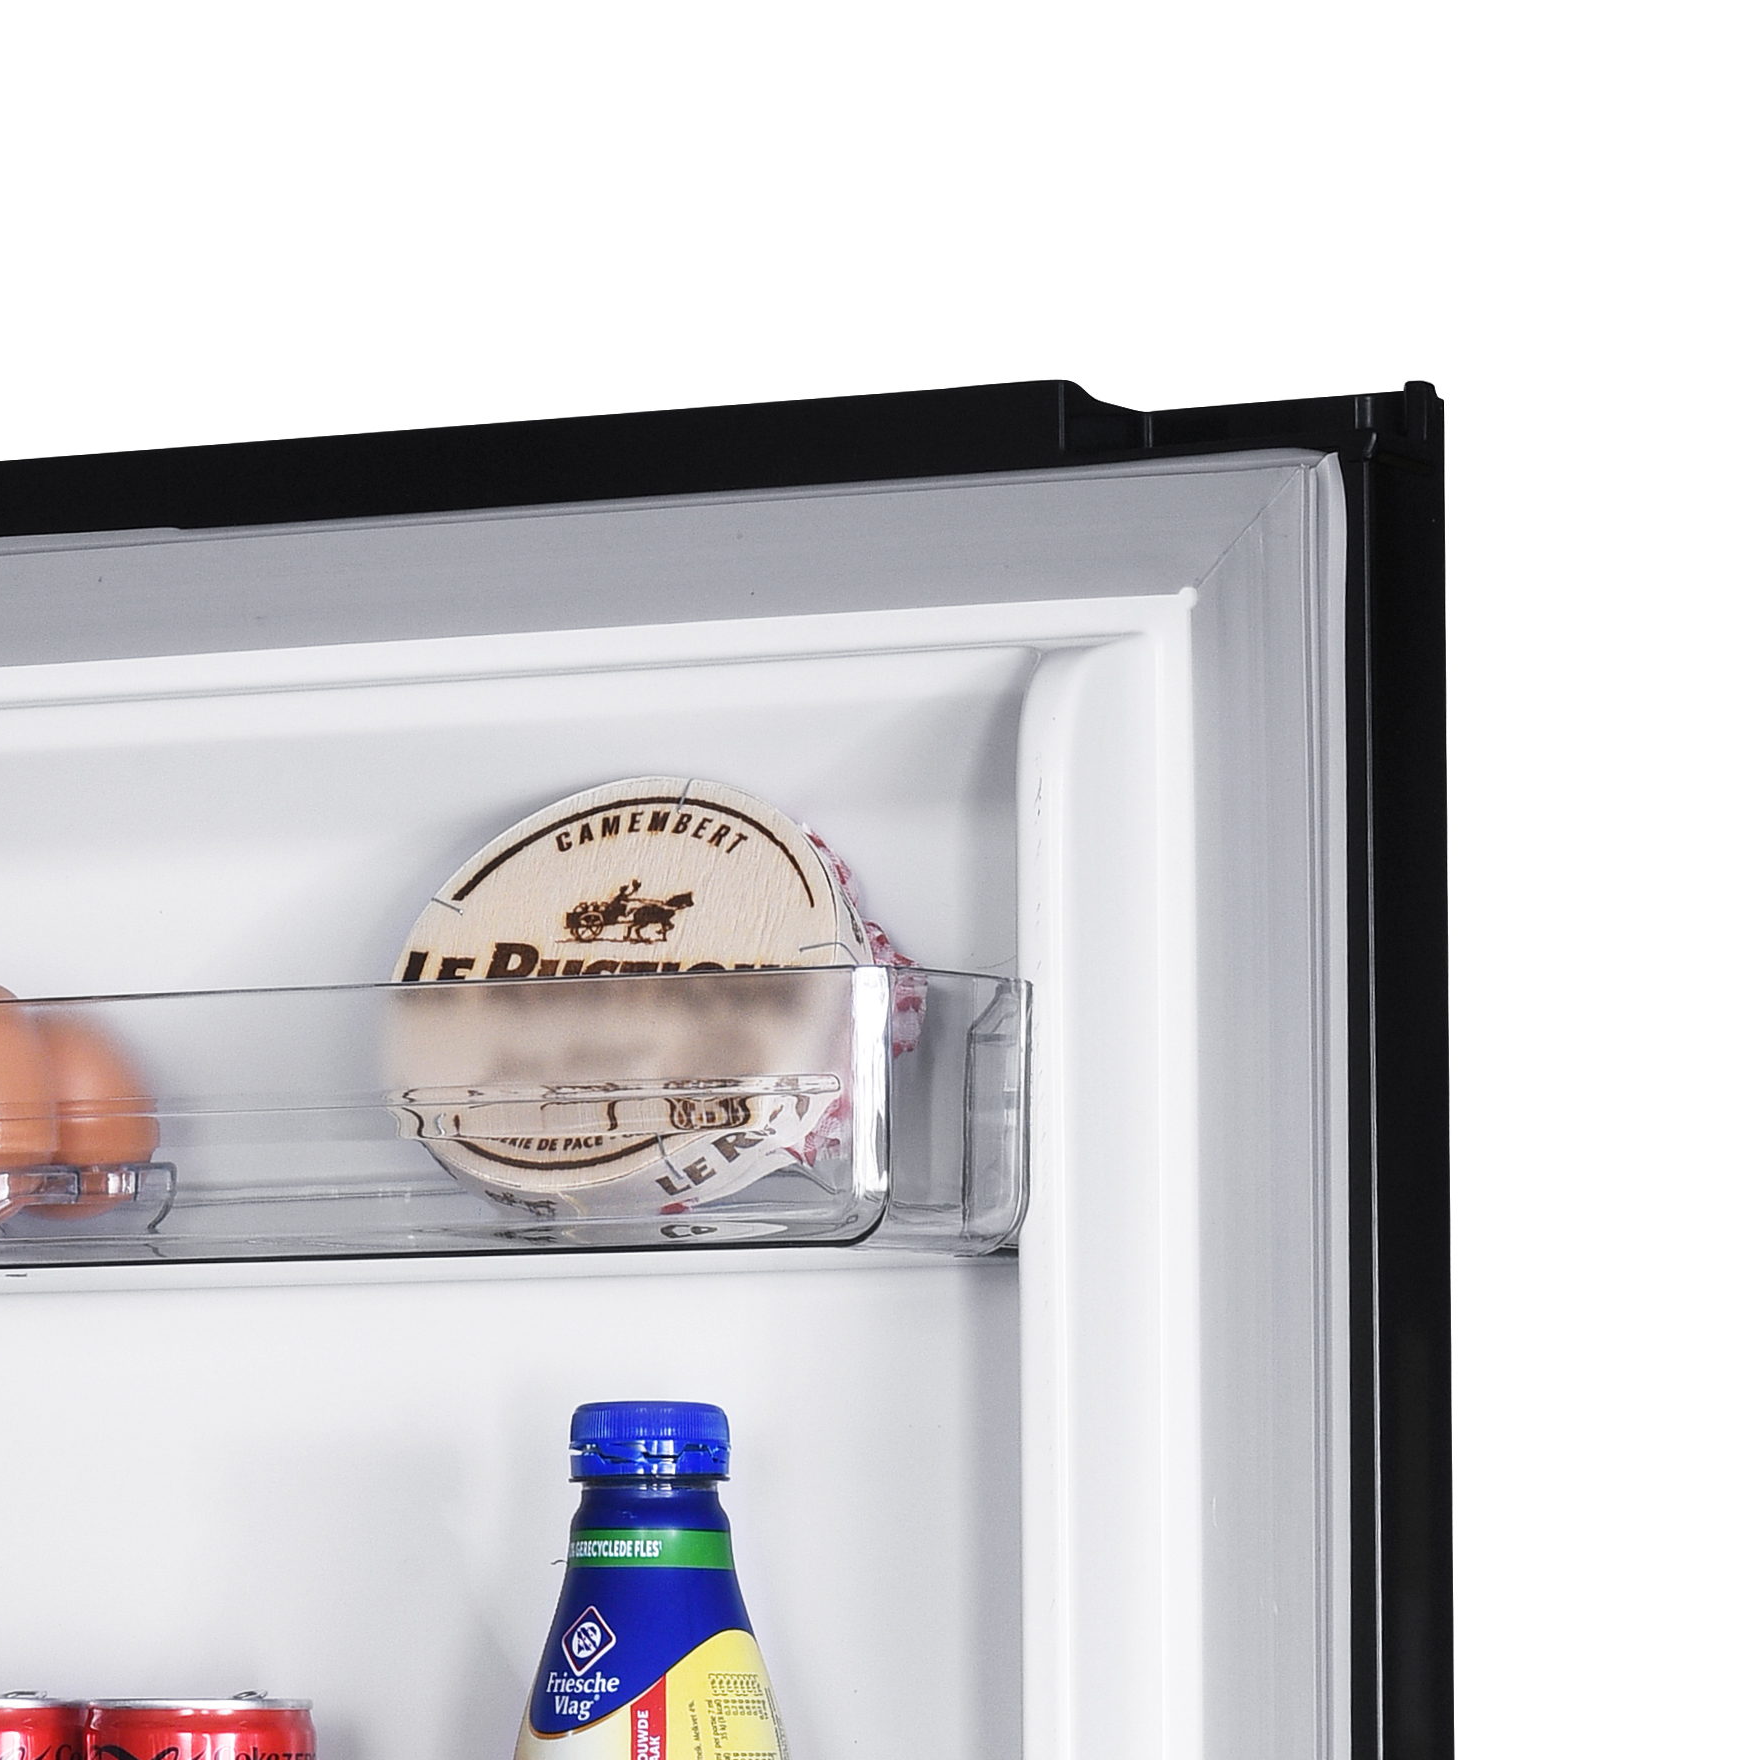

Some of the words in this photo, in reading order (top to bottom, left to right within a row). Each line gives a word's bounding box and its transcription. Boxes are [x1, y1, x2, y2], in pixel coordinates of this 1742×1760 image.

[556, 809, 749, 855] CAMEMBERT
[575, 1540, 634, 1557] GERECYCLEDE
[546, 1672, 620, 1693] Friesche
[555, 1695, 594, 1721] Vlag
